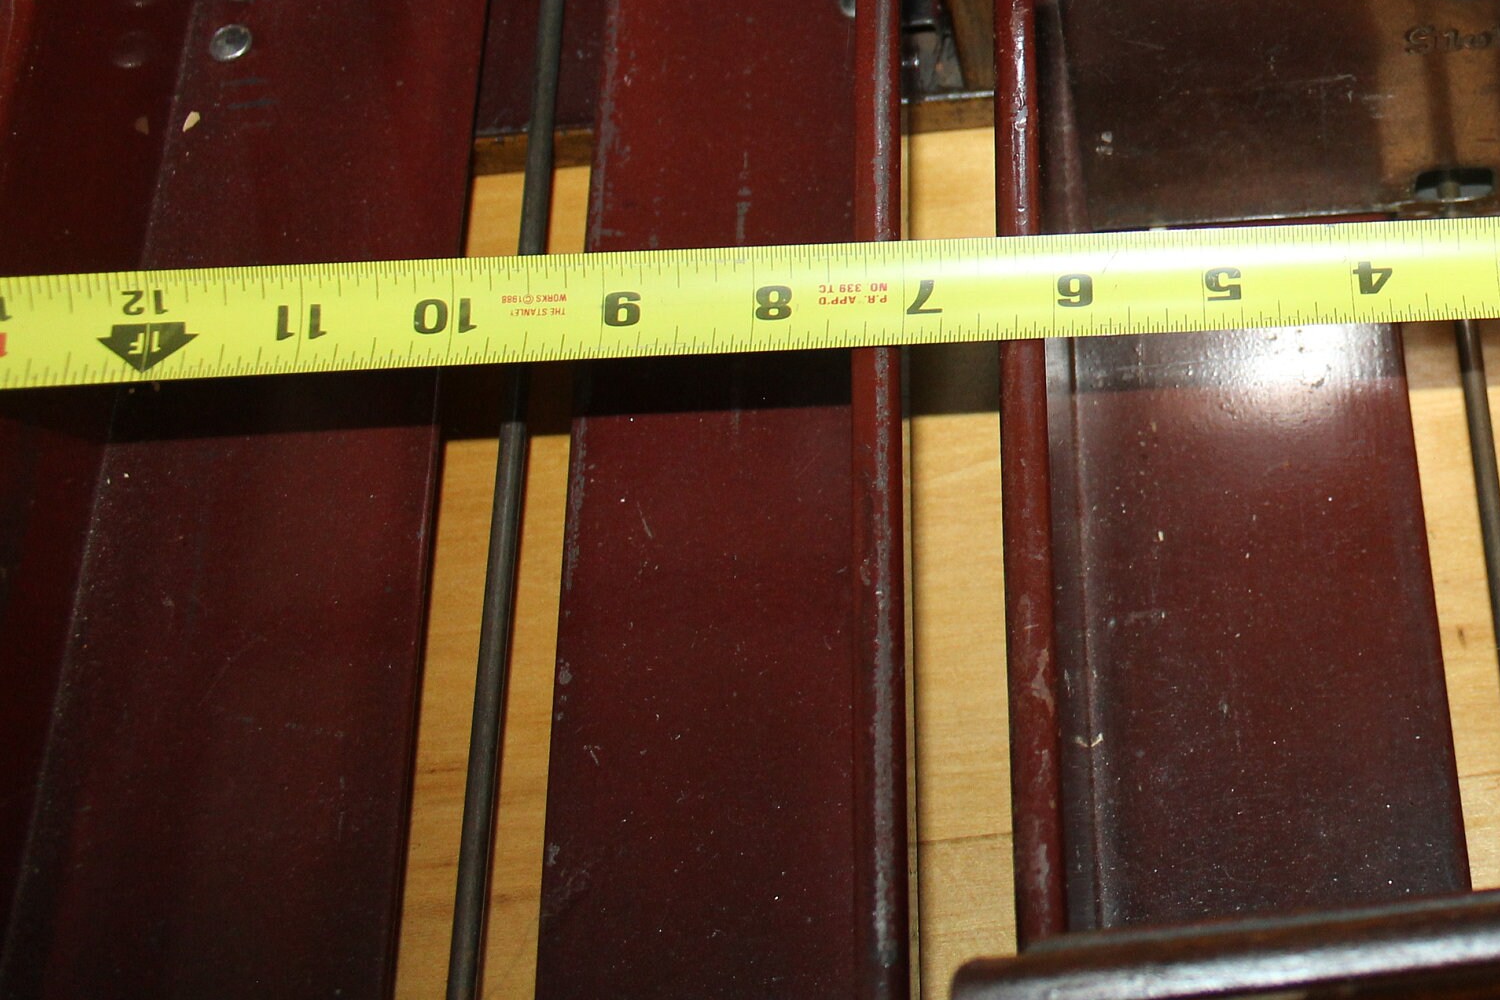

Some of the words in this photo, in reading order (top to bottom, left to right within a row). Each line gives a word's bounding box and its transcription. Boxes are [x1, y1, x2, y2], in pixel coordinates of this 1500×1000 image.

[818, 284, 835, 294] TC
[838, 283, 862, 293] 339
[1056, 273, 1094, 308] 6
[1204, 267, 1242, 301] 5
[1353, 261, 1393, 295] 4
[121, 289, 169, 316] 12
[536, 293, 567, 304] WORKS
[549, 307, 566, 317] THE
[603, 291, 642, 327] 9
[755, 285, 793, 321] 8
[906, 279, 943, 315] 7
[276, 304, 327, 341] 11
[413, 297, 478, 335] 10
[128, 331, 162, 356] 1F
